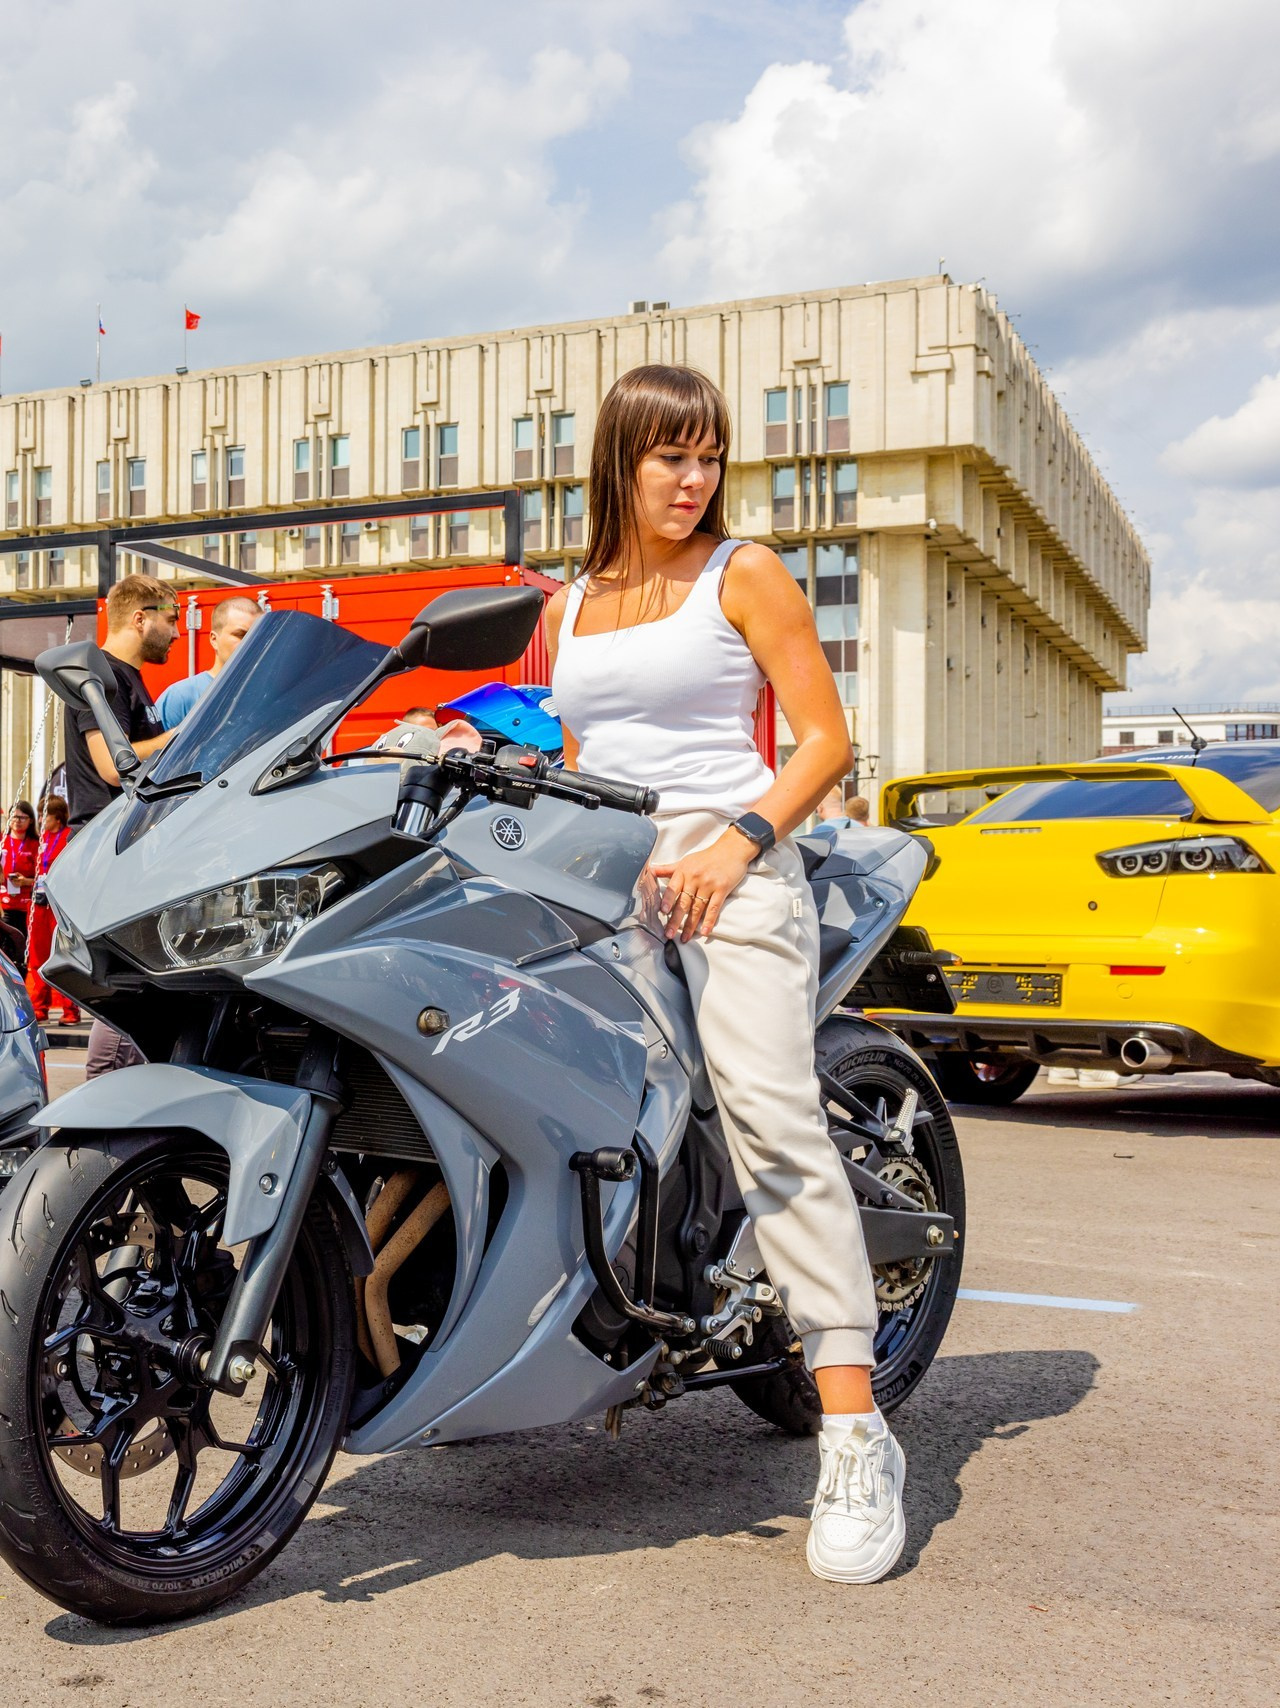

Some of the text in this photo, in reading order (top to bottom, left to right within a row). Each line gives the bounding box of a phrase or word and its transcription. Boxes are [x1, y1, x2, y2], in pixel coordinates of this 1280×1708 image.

[839, 1051, 887, 1073] MICHELIN
[874, 1378, 906, 1404] MICHE
[191, 1556, 245, 1587] MICHELIN
[151, 1581, 181, 1591] 110/70
